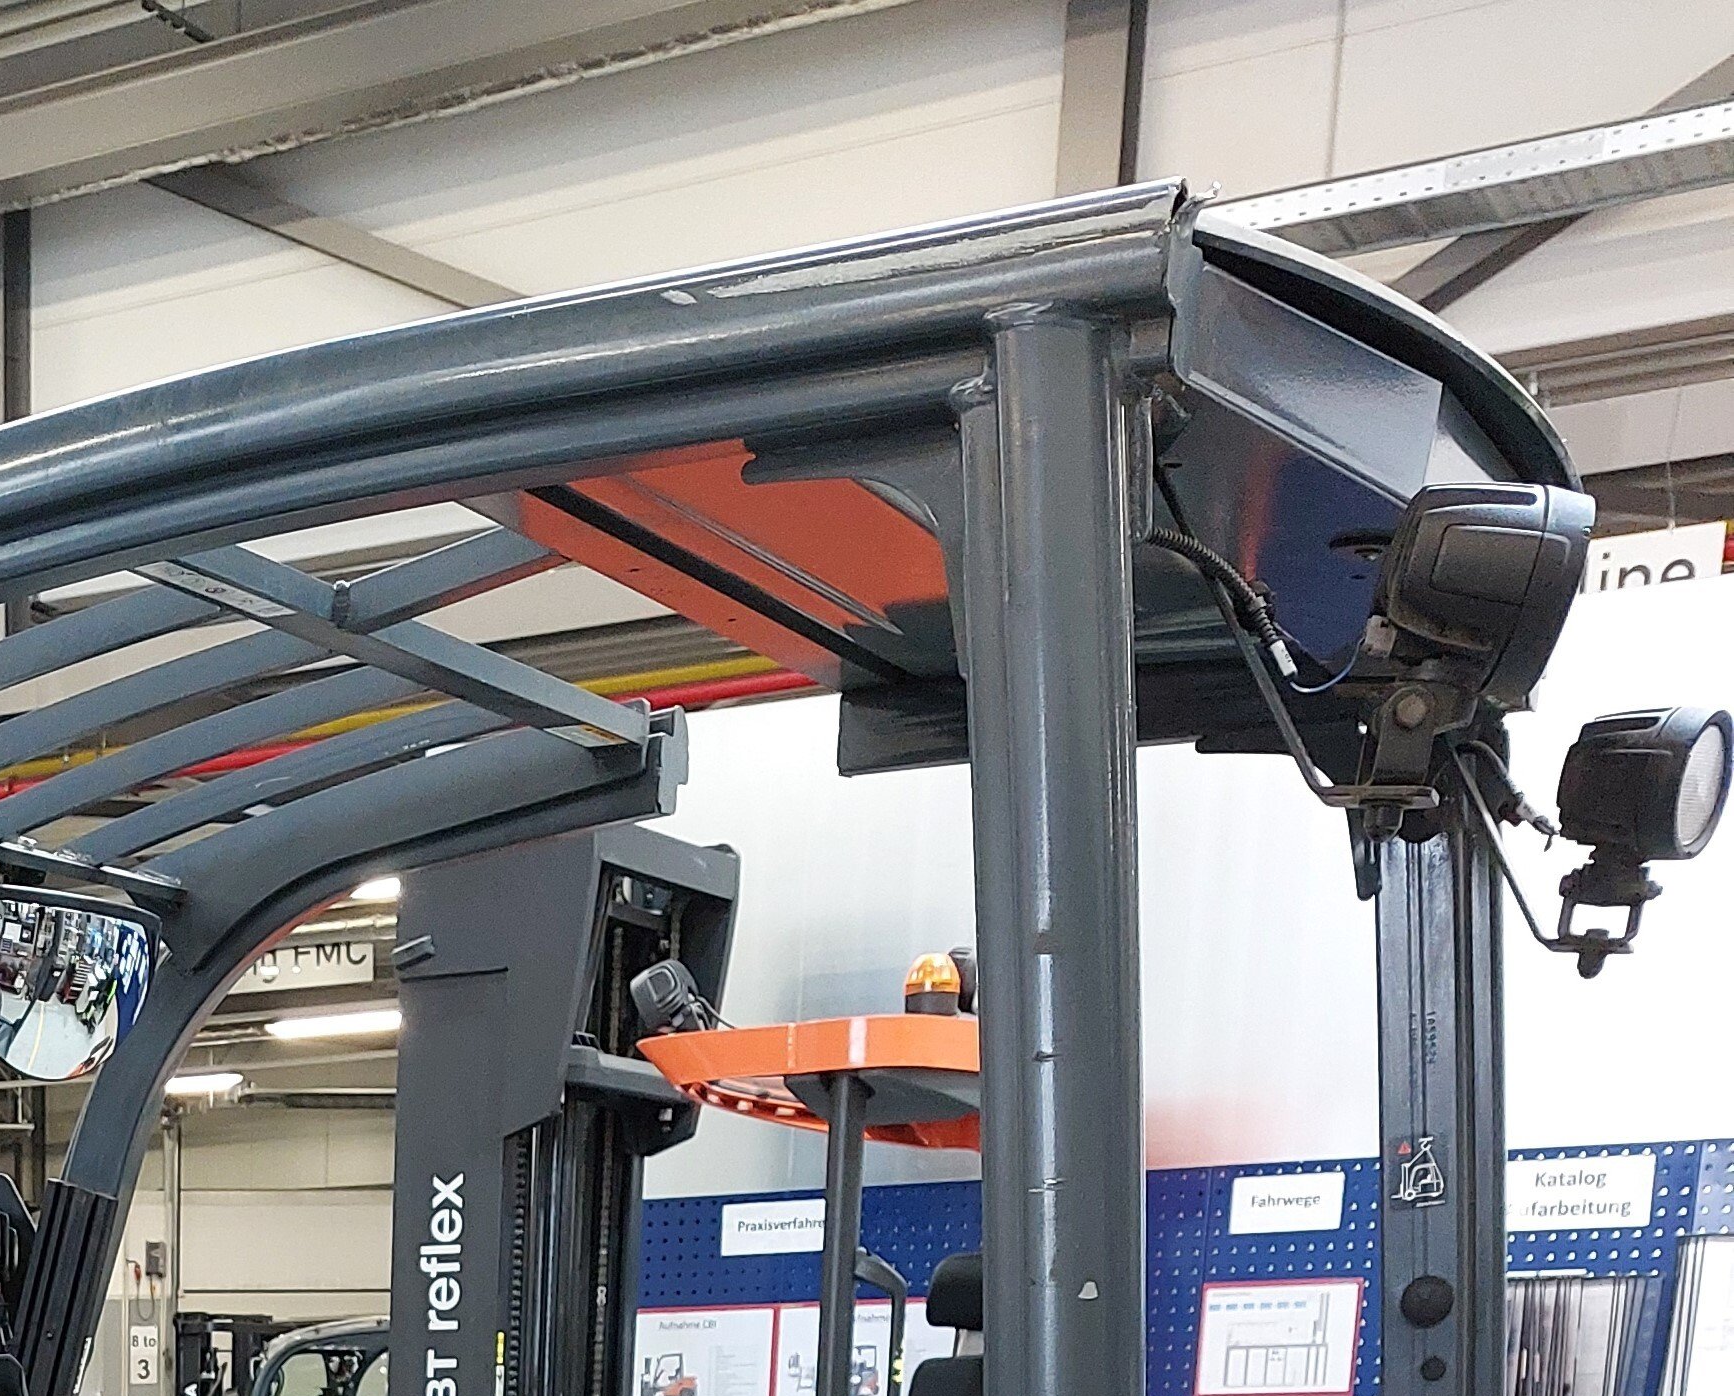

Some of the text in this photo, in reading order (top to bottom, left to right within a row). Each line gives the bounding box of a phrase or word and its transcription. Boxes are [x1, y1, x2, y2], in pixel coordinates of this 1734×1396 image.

[1535, 1169, 1607, 1189] Katalog
[1250, 1193, 1321, 1213] Fahrwege
[420, 1172, 465, 1332] reflex
[137, 1359, 151, 1380] 3
